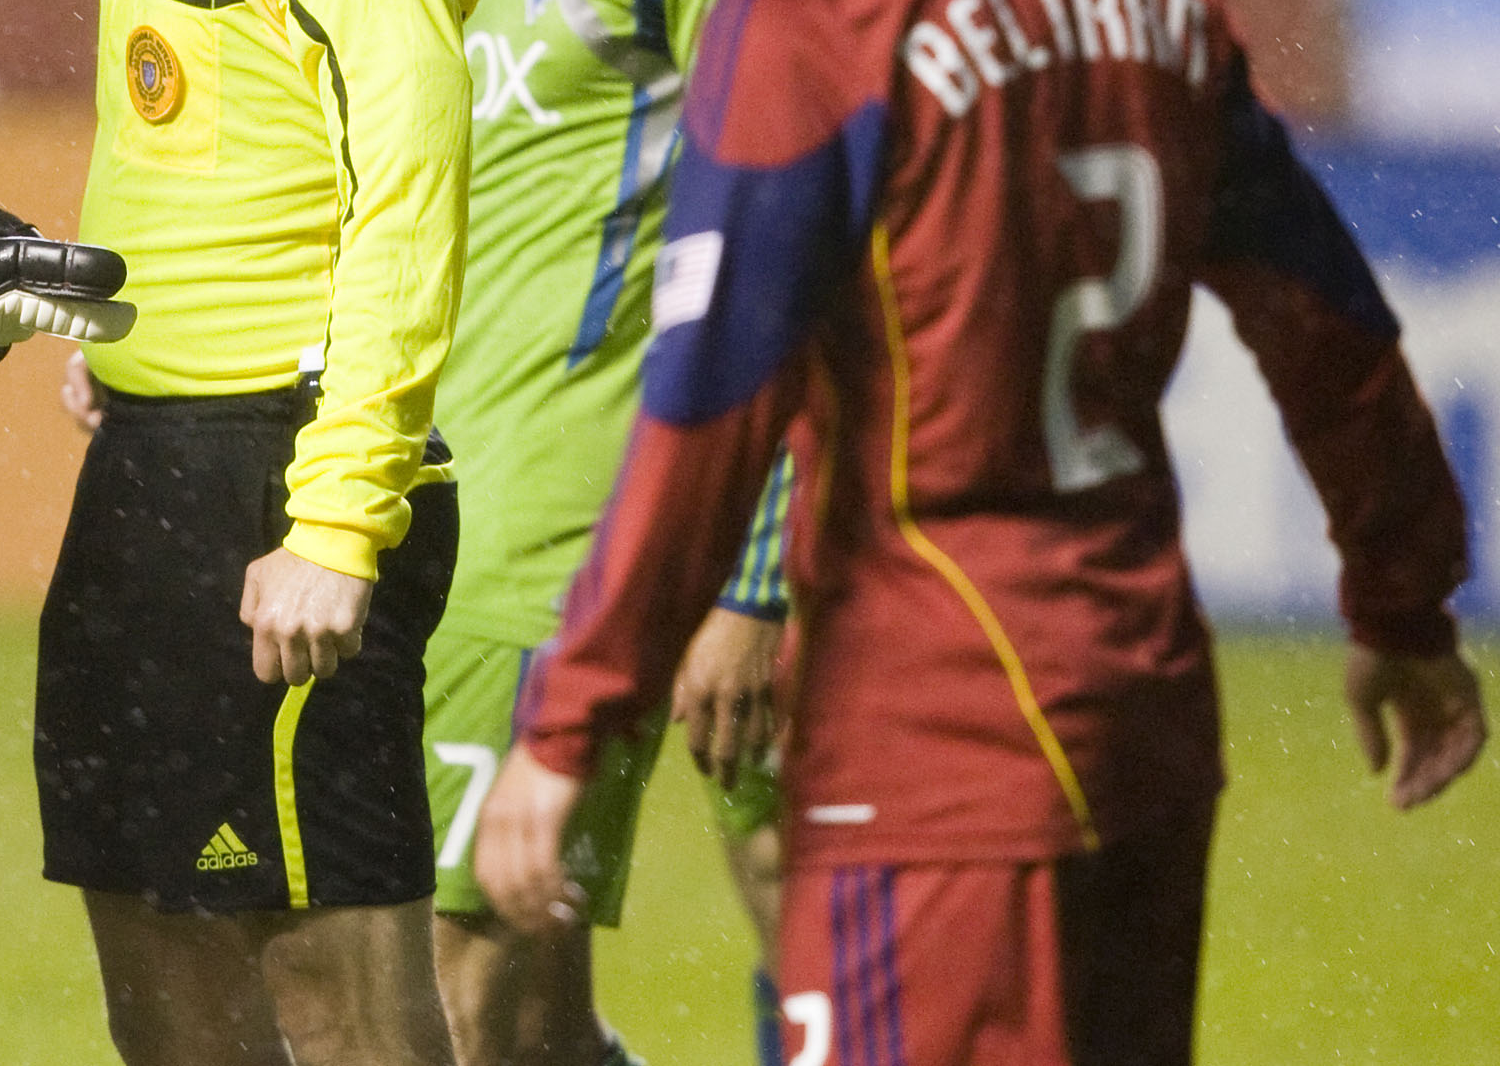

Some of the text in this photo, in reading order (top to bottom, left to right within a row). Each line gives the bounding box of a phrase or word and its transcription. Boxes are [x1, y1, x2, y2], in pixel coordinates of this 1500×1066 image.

[1041, 143, 1166, 494] 2
[196, 851, 259, 871] adidas
[432, 742, 498, 869] 7
